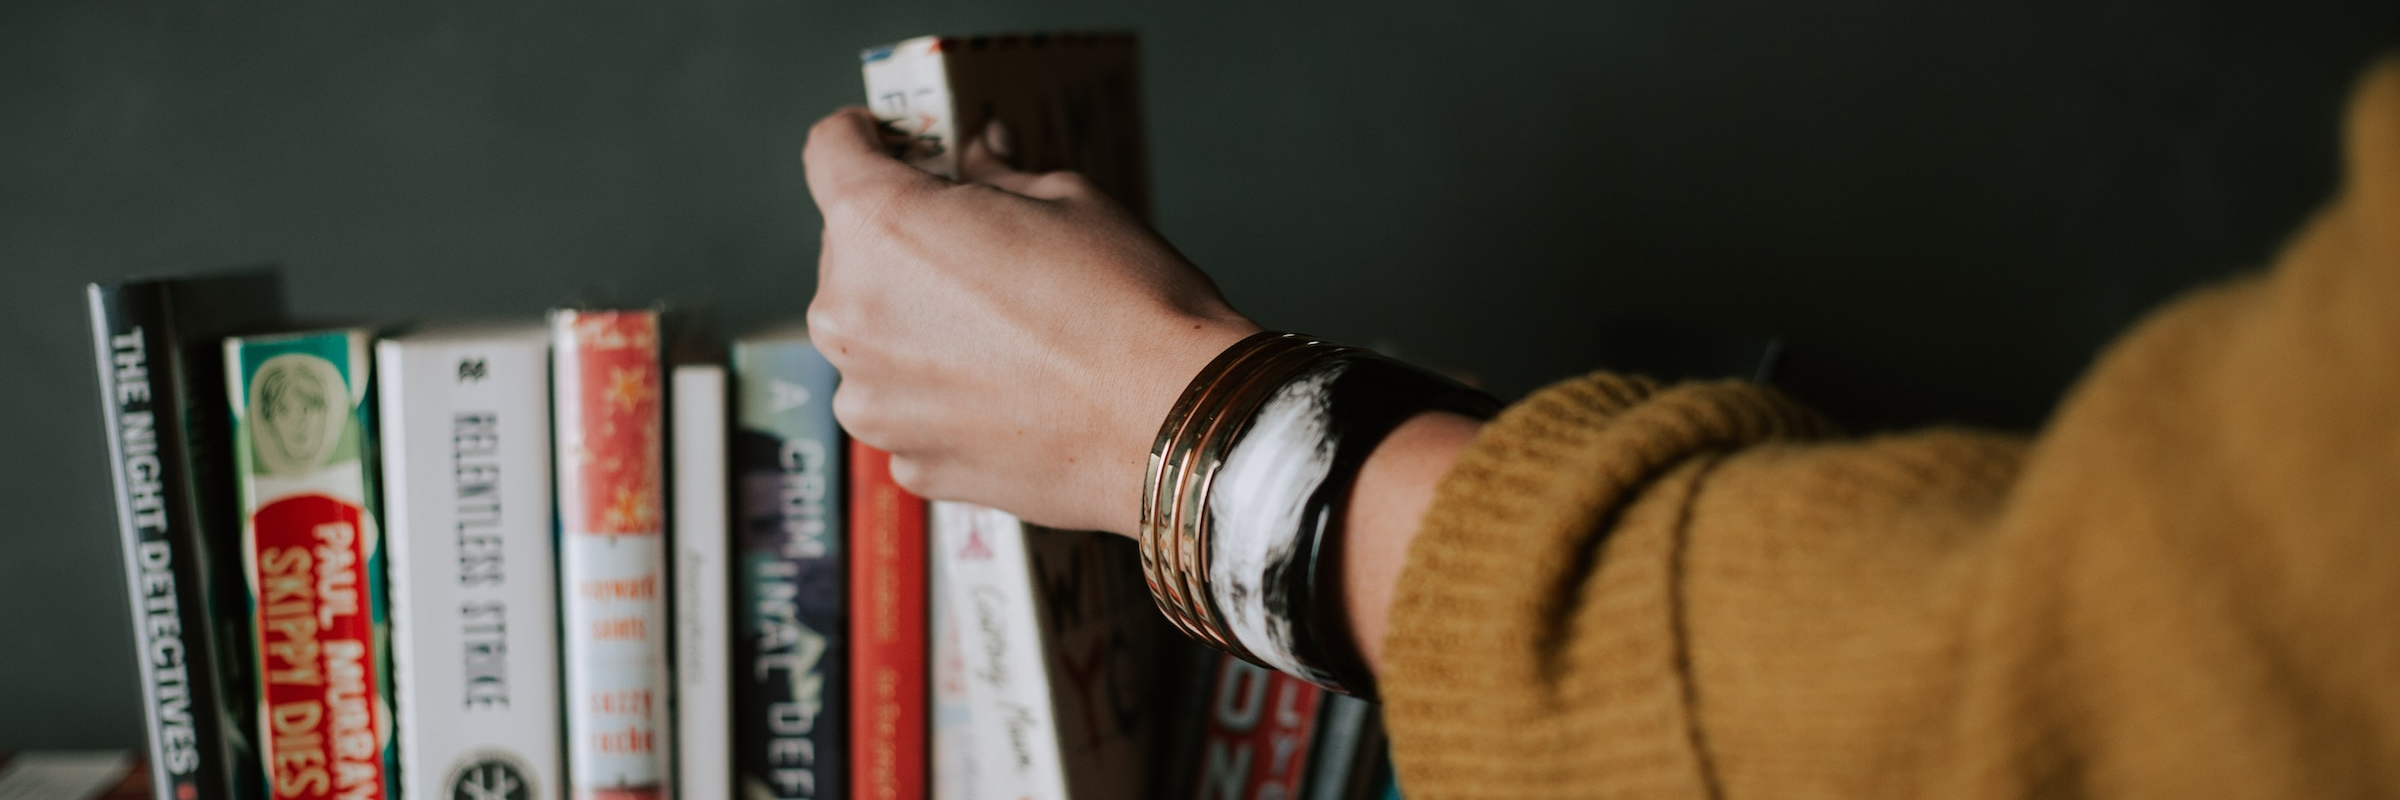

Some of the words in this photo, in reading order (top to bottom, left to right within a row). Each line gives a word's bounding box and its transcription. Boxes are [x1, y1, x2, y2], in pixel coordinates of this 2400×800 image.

[111, 325, 151, 405] THE
[771, 377, 812, 414] A
[120, 412, 167, 533] NIGHT
[453, 411, 505, 590] RELENTLESS
[260, 545, 324, 686] SKIPPY
[312, 520, 360, 630] PAUL
[138, 539, 201, 776] DETECTIVES
[461, 603, 511, 712] STRIKE
[272, 702, 332, 799] DIES
[766, 702, 817, 800] DEF
